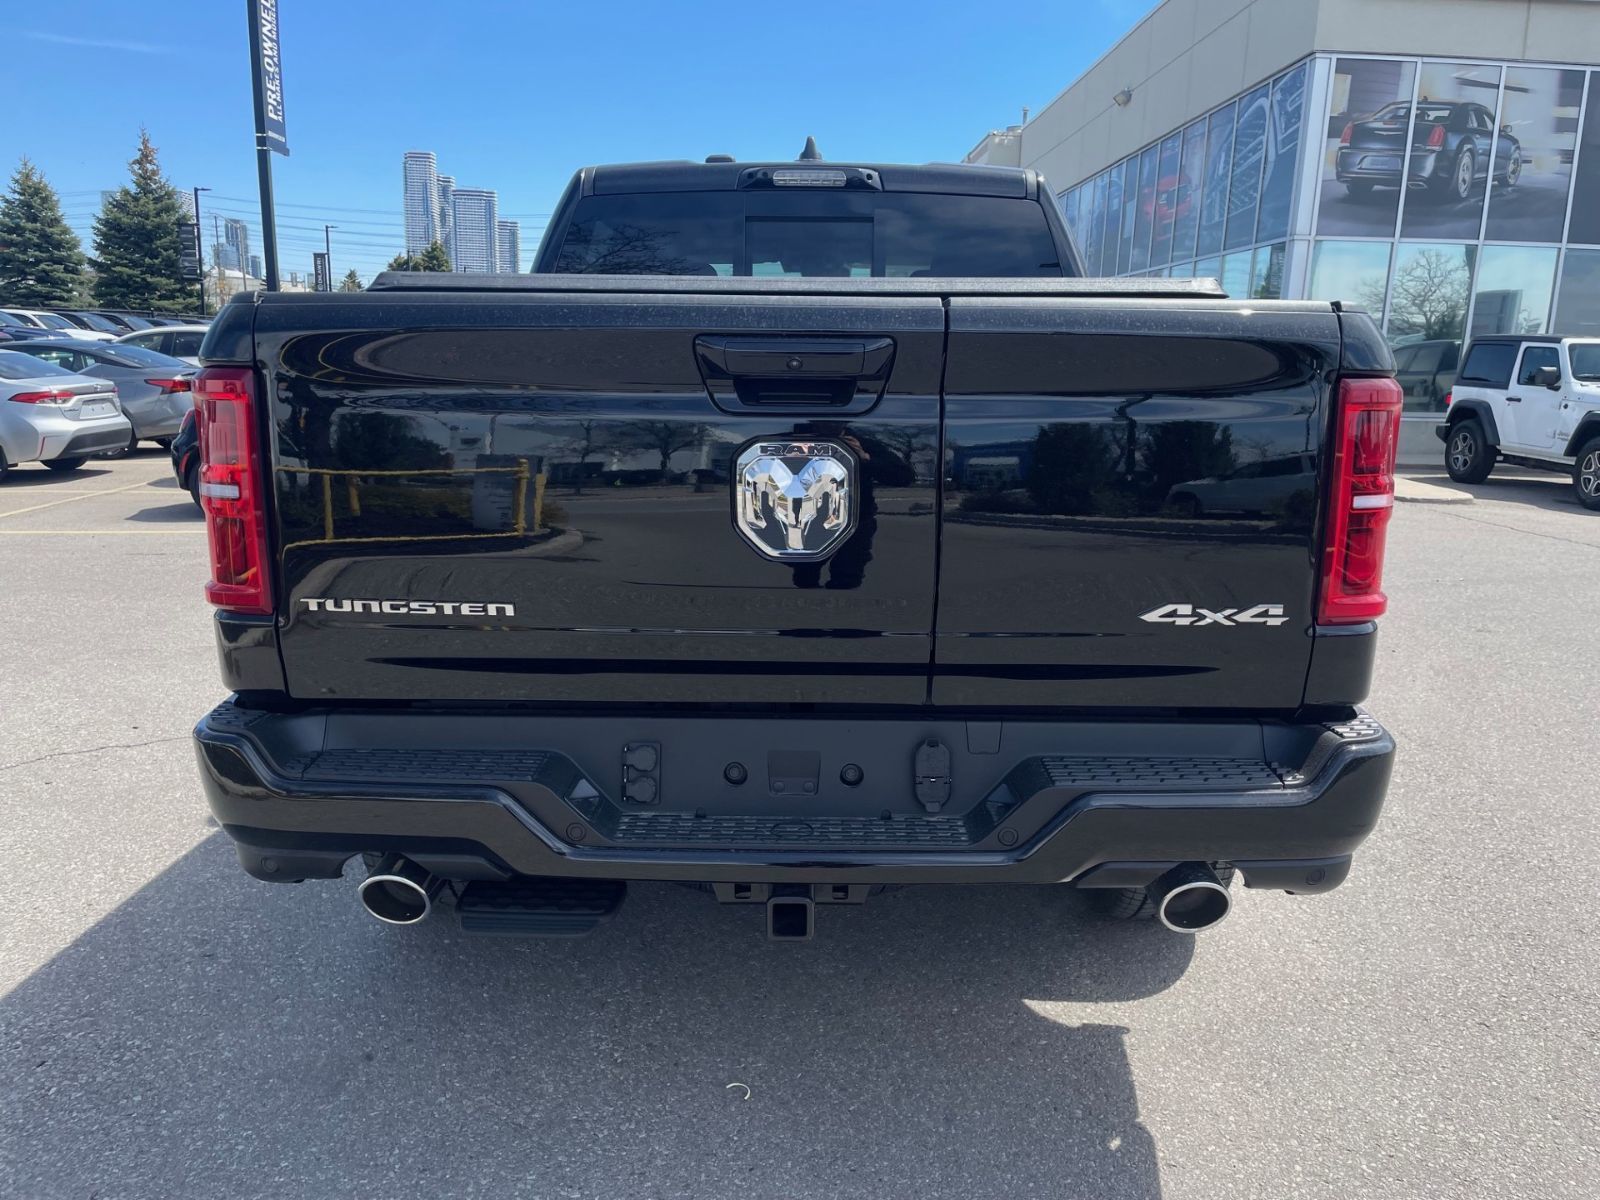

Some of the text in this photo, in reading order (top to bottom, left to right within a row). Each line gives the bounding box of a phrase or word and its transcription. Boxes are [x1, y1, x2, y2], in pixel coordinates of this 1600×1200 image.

[273, 67, 282, 102] MAKES
[758, 444, 832, 456] RAM
[300, 598, 515, 616] TUNGSTEN
